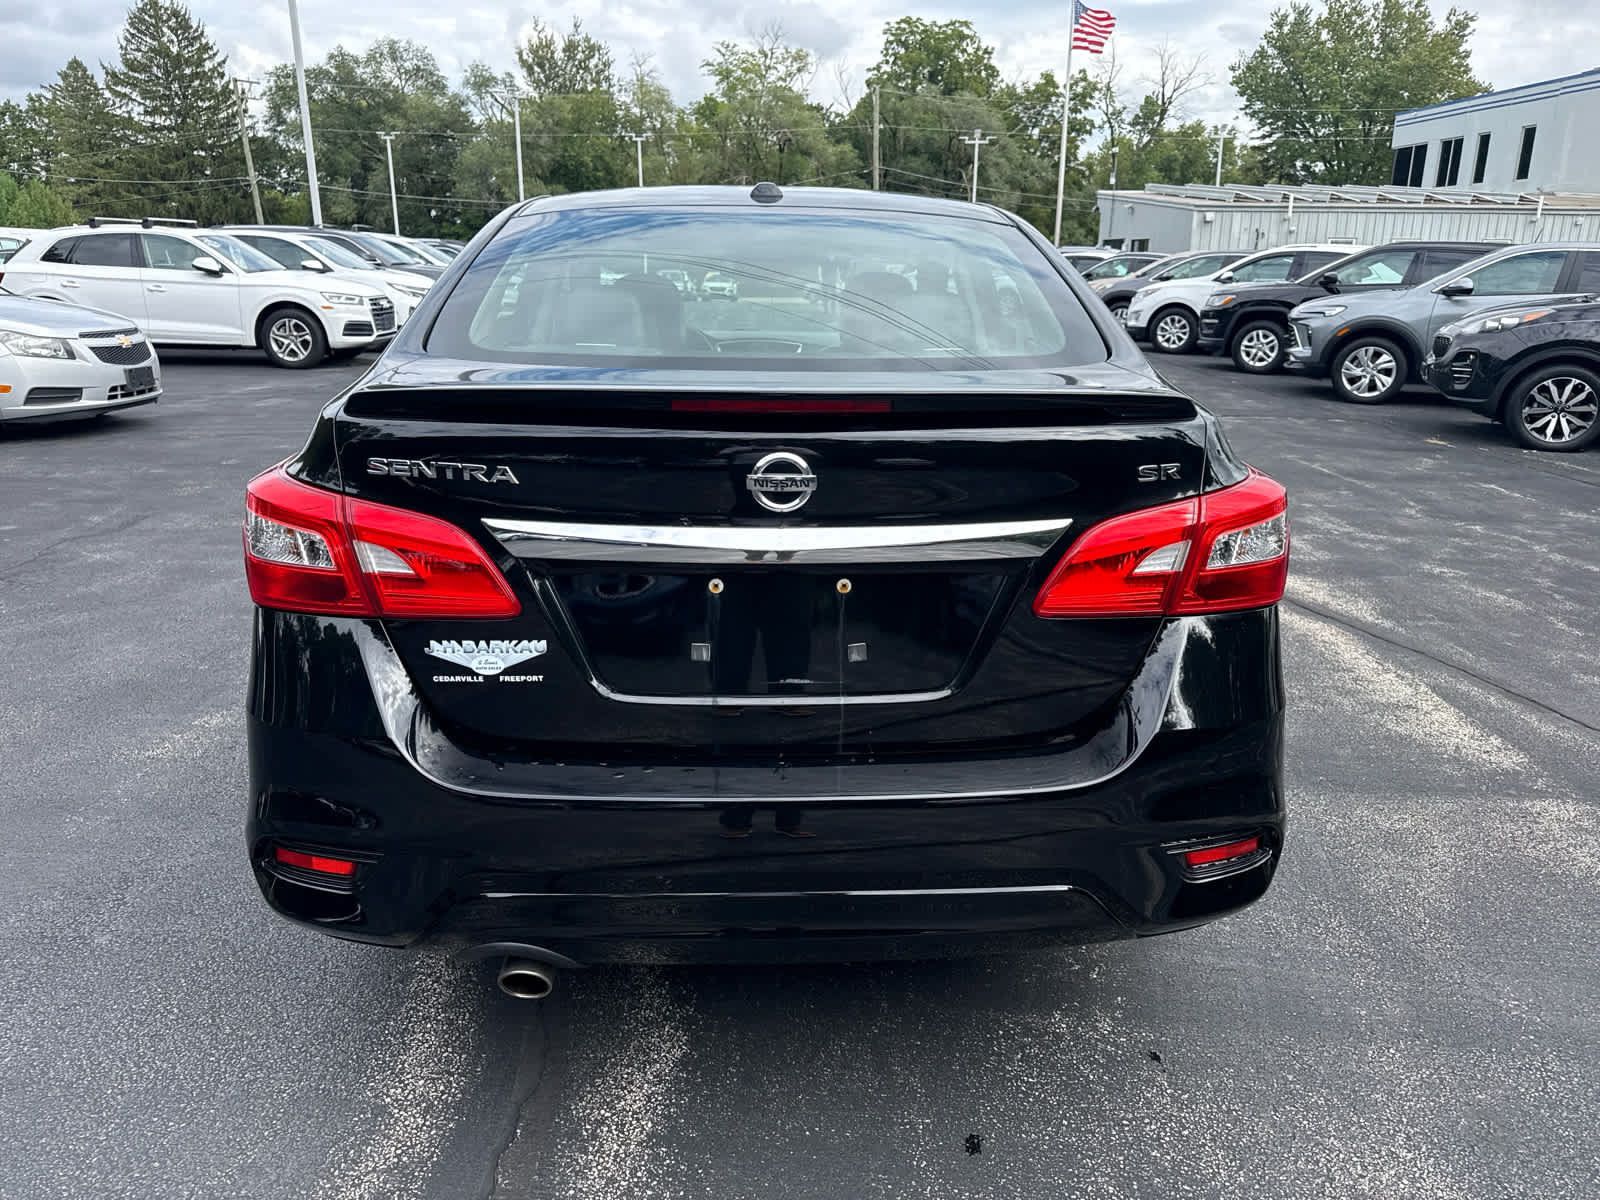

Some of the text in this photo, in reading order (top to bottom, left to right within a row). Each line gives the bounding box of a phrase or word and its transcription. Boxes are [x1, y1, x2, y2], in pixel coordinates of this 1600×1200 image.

[366, 457, 520, 485] SENTRA
[1137, 463, 1182, 482] SR
[753, 478, 811, 489] NISSAN
[432, 675, 544, 683] CEDARVILLE FREEPORT
